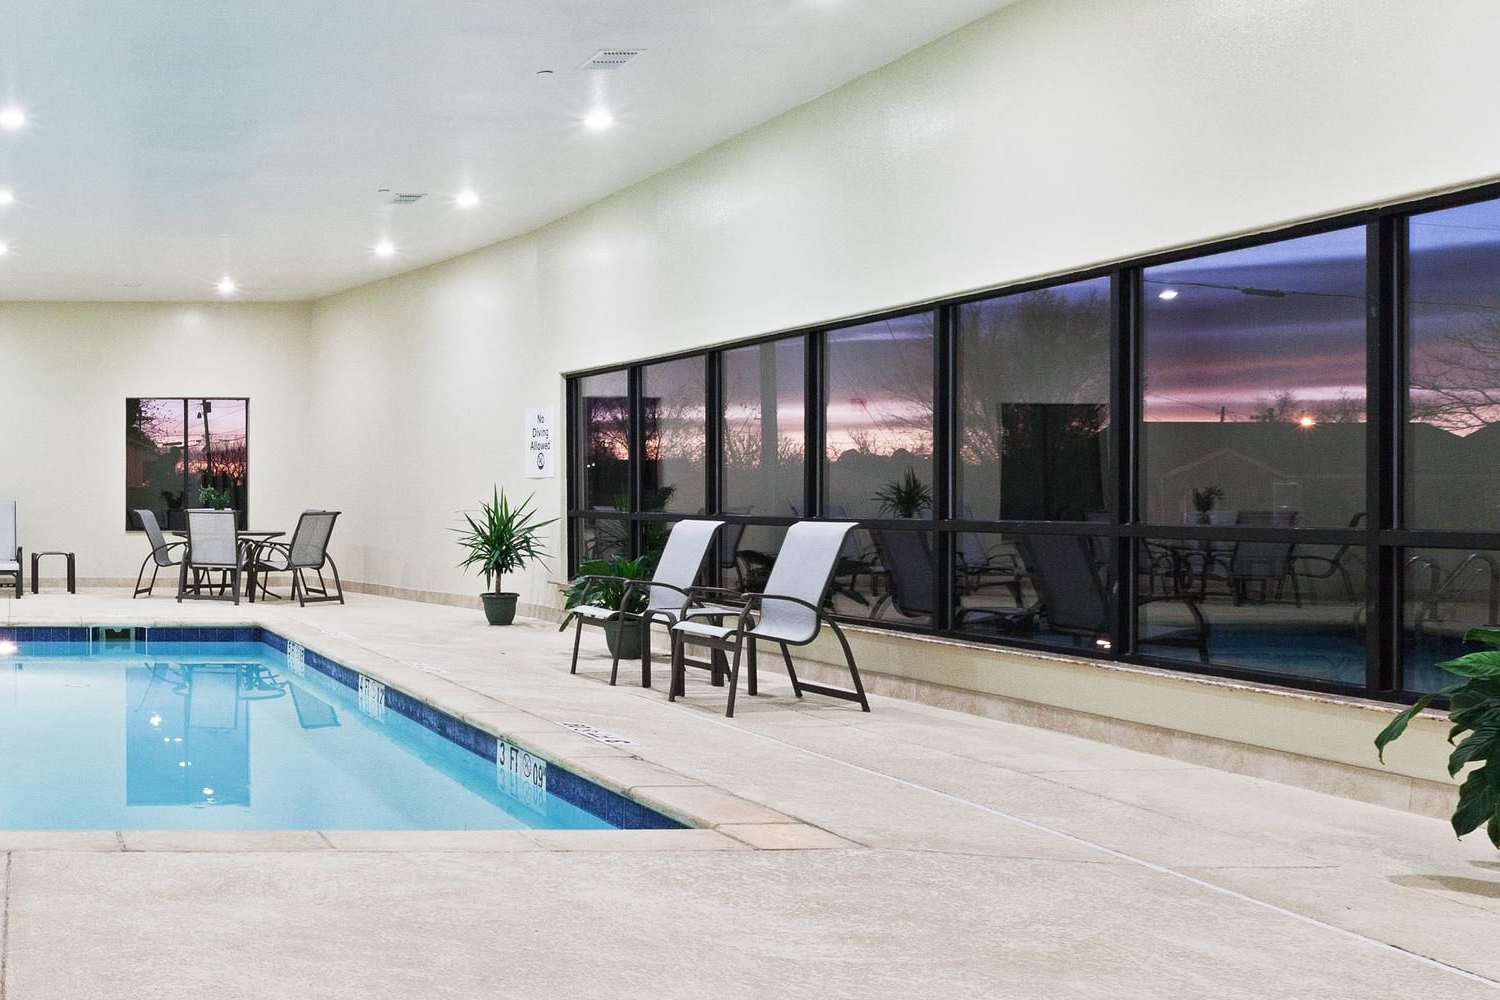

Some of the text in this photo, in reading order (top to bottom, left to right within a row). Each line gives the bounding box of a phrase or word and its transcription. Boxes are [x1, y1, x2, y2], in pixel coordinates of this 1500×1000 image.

[537, 413, 545, 424] No
[532, 427, 549, 439] Diving
[530, 440, 550, 451] Allowed
[500, 742, 506, 765] 3
[510, 746, 519, 773] FT
